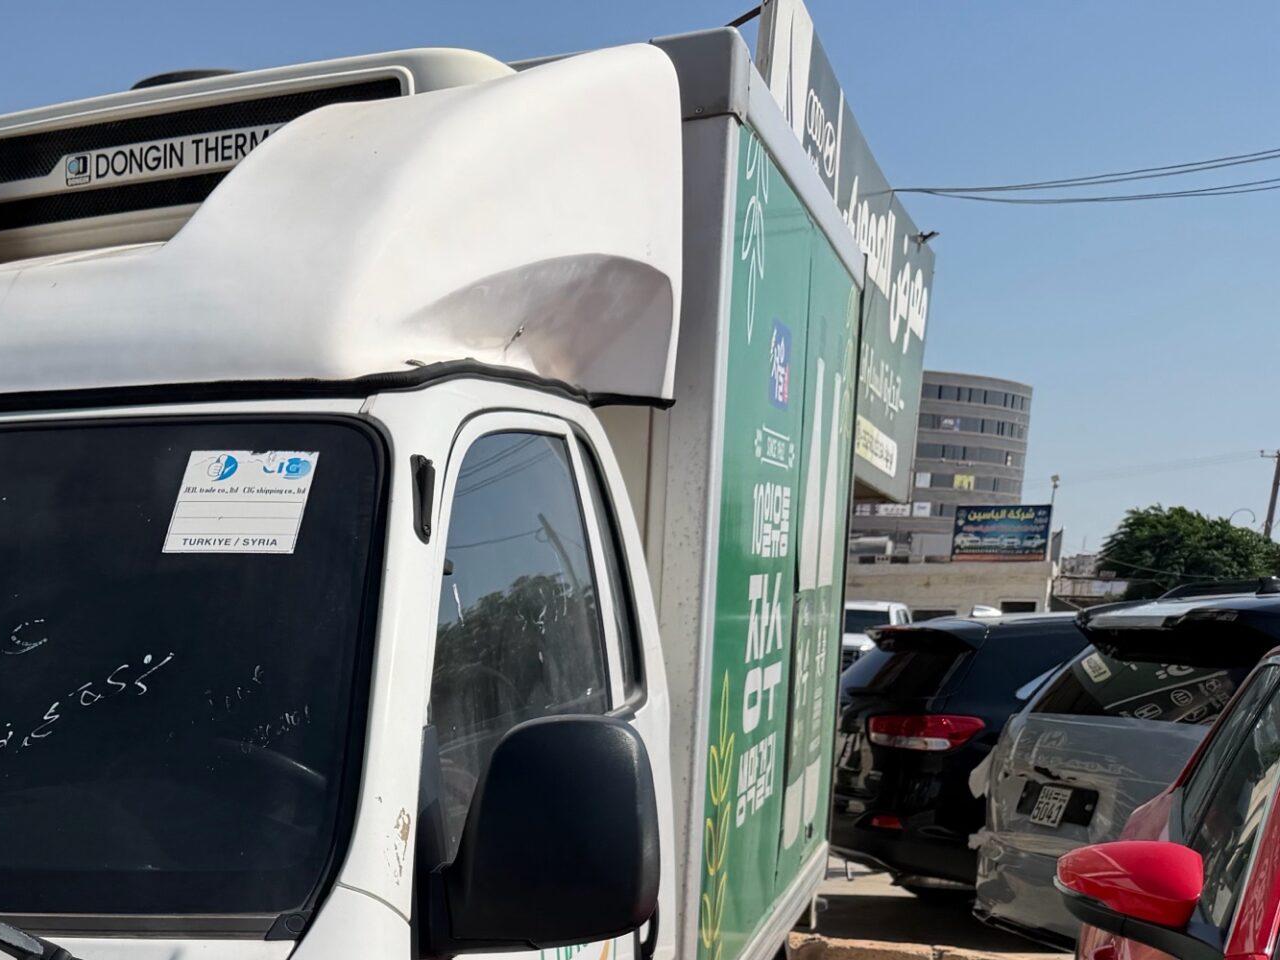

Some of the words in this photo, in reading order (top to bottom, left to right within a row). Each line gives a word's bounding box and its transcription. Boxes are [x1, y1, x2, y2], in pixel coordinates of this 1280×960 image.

[95, 141, 185, 180] DONGIN
[191, 128, 271, 166] THERM
[241, 537, 279, 547] SYRIA
[735, 731, 778, 828] 생막걸리
